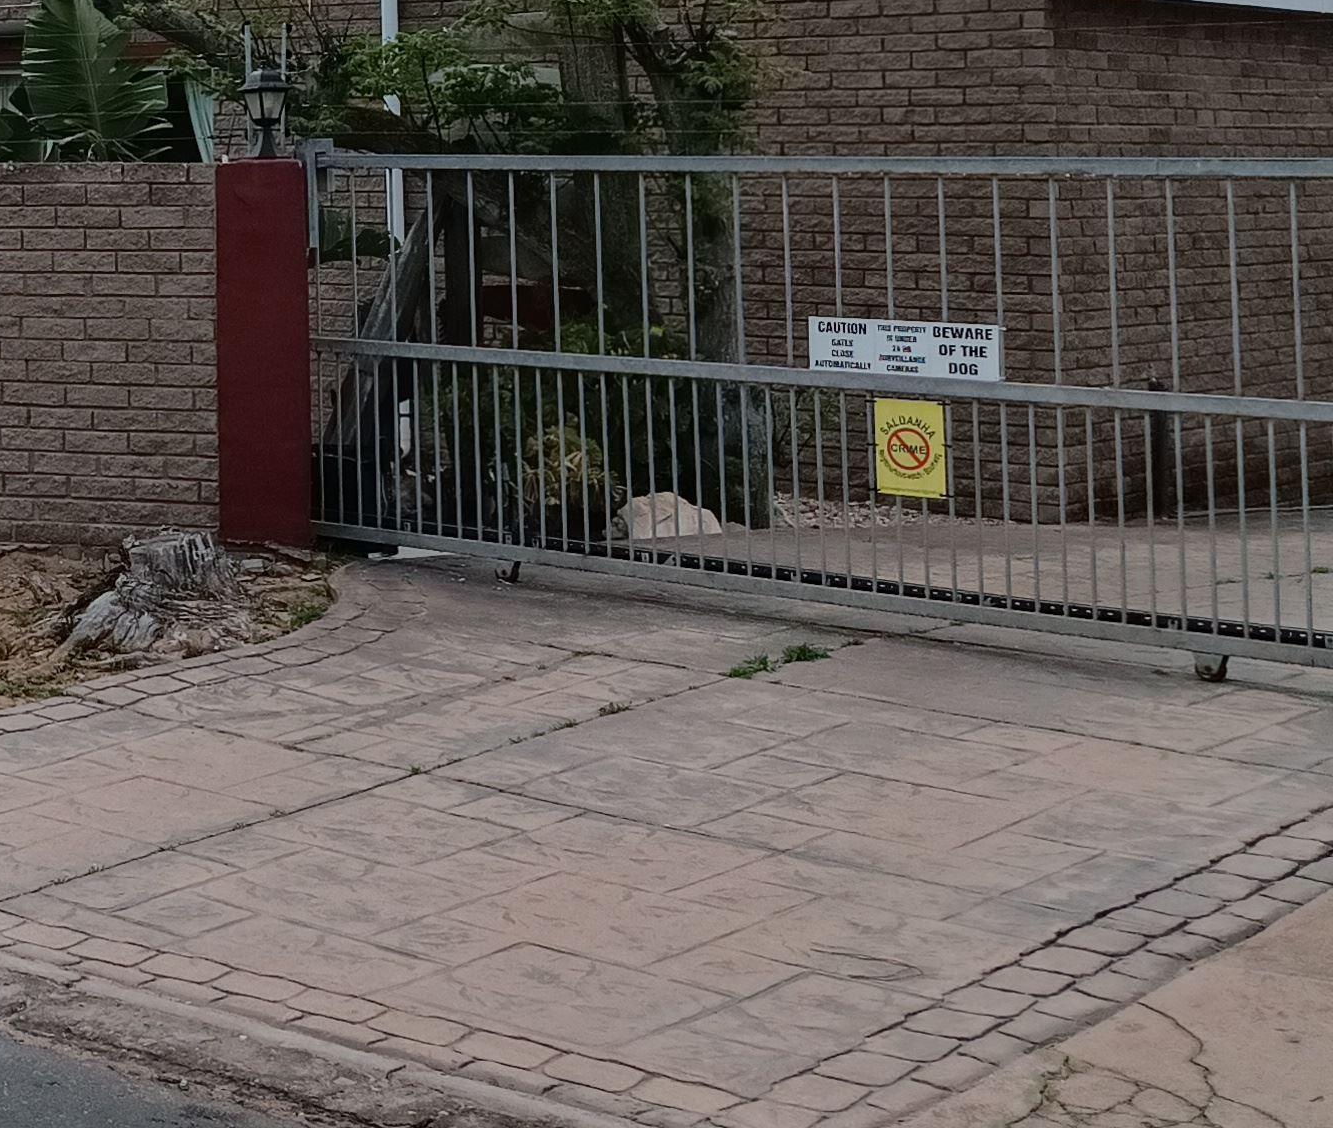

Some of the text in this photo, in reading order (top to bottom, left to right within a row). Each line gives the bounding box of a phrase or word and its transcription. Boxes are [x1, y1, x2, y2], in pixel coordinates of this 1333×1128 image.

[818, 321, 867, 335] CAUTION
[933, 326, 993, 340] BEWARE
[831, 339, 853, 347] GATES
[831, 350, 853, 358] CLOSE
[939, 344, 987, 358] OF THE
[815, 360, 871, 370] AUTOMATICALLY
[949, 363, 978, 375] DOG
[880, 415, 936, 440] SALDANHA
